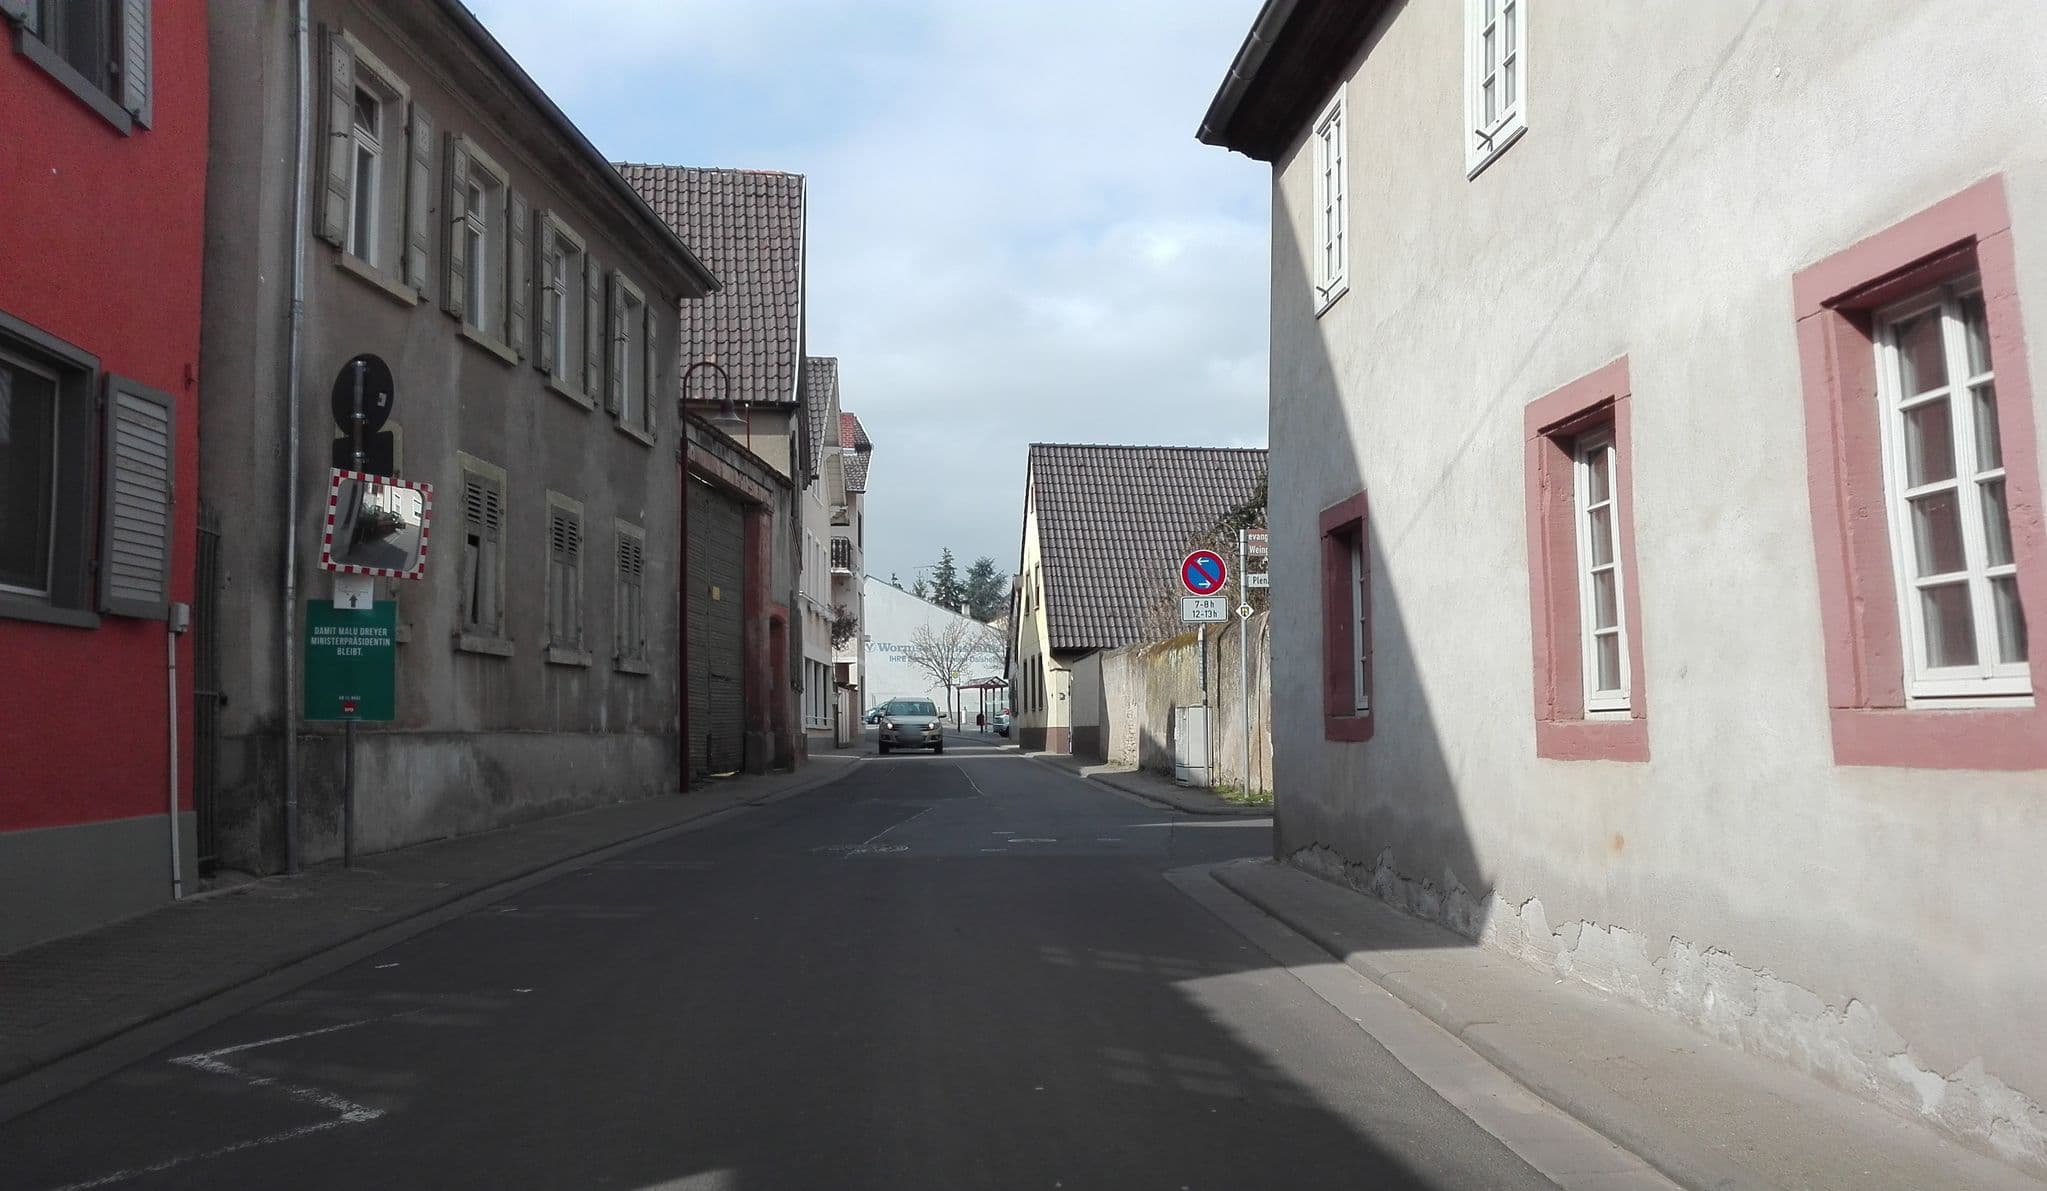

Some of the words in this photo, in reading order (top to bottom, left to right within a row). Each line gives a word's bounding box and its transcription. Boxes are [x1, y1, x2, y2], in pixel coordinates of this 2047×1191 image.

[1252, 576, 1269, 584] Plen
[1192, 610, 1212, 618] 12-13
[314, 626, 336, 635] DAMIT
[338, 627, 358, 635] MALU
[359, 627, 388, 636] DREYER
[311, 636, 391, 647] MINISTERPRÄSIDENTIN
[889, 655, 906, 663] IHRE
